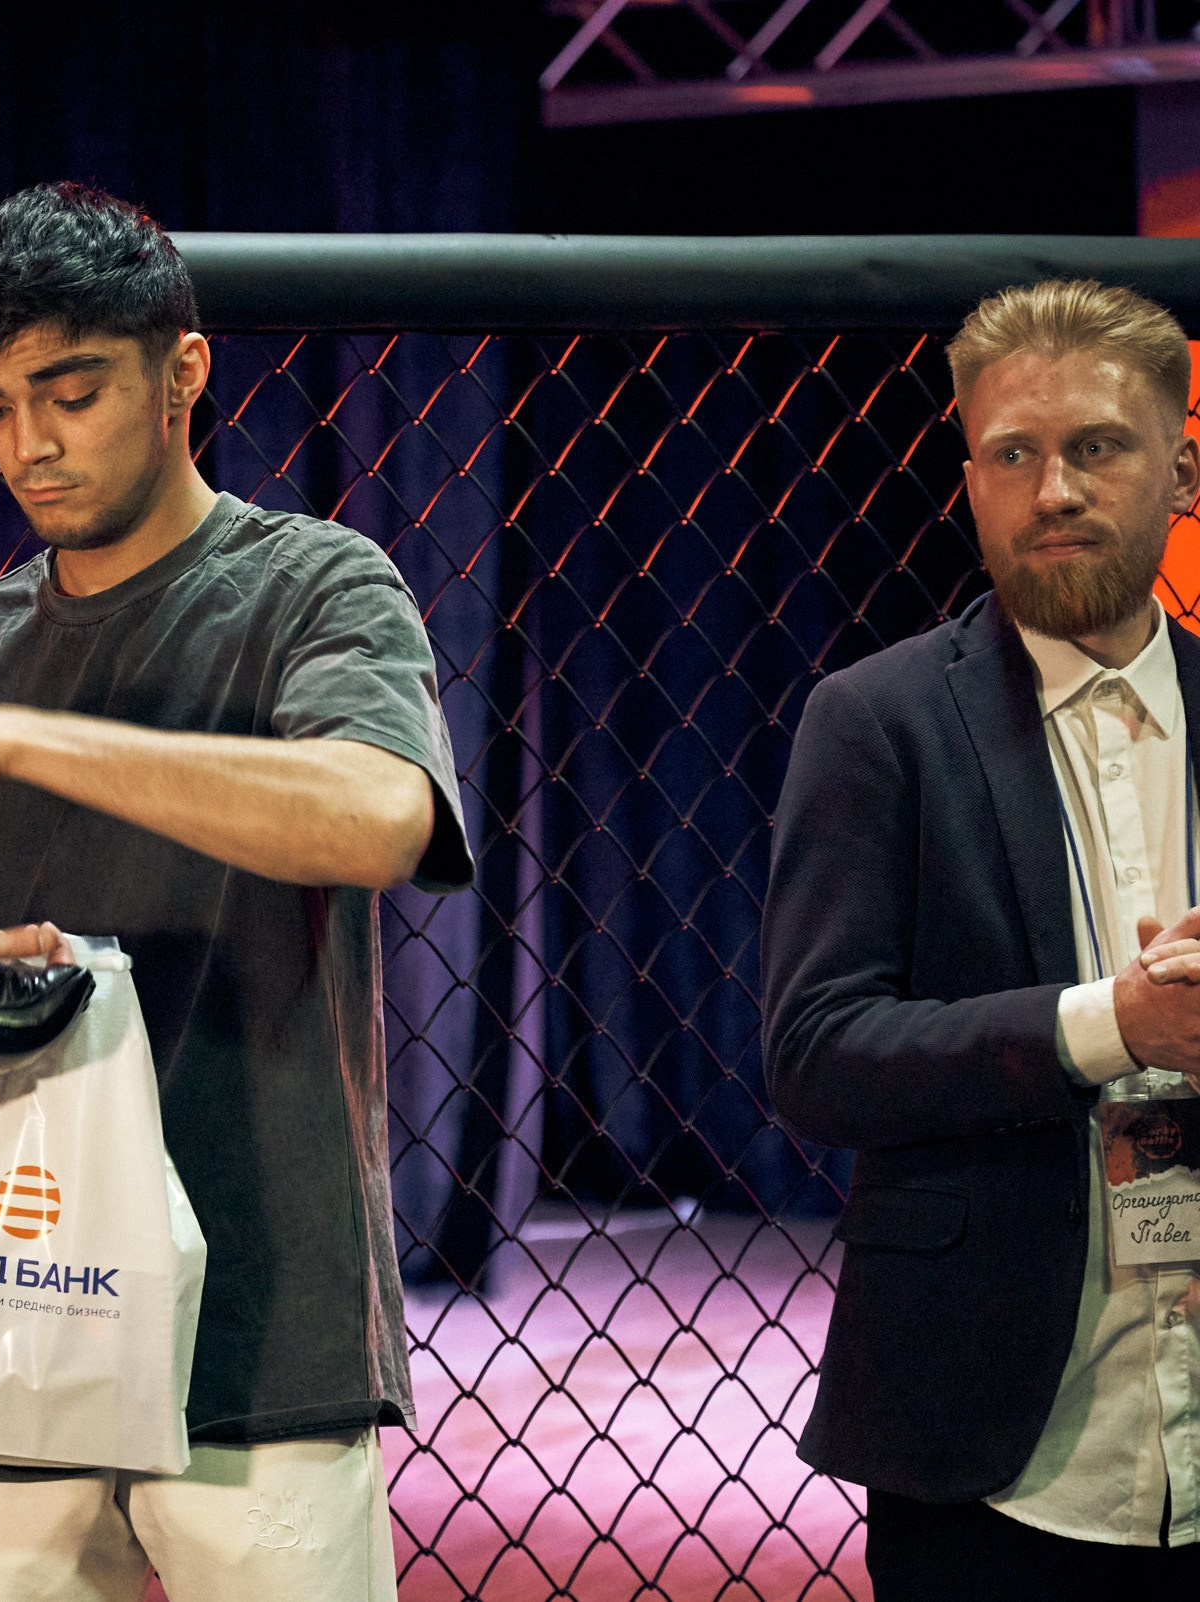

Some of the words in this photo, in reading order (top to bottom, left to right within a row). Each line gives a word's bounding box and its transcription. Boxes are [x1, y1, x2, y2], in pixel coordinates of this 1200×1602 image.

[1112, 1192, 1200, 1219] Организато
[1130, 1218, 1192, 1244] Павел
[15, 1258, 120, 1297] БАНК
[8, 1298, 63, 1316] среднего
[67, 1304, 121, 1320] бизнеса
